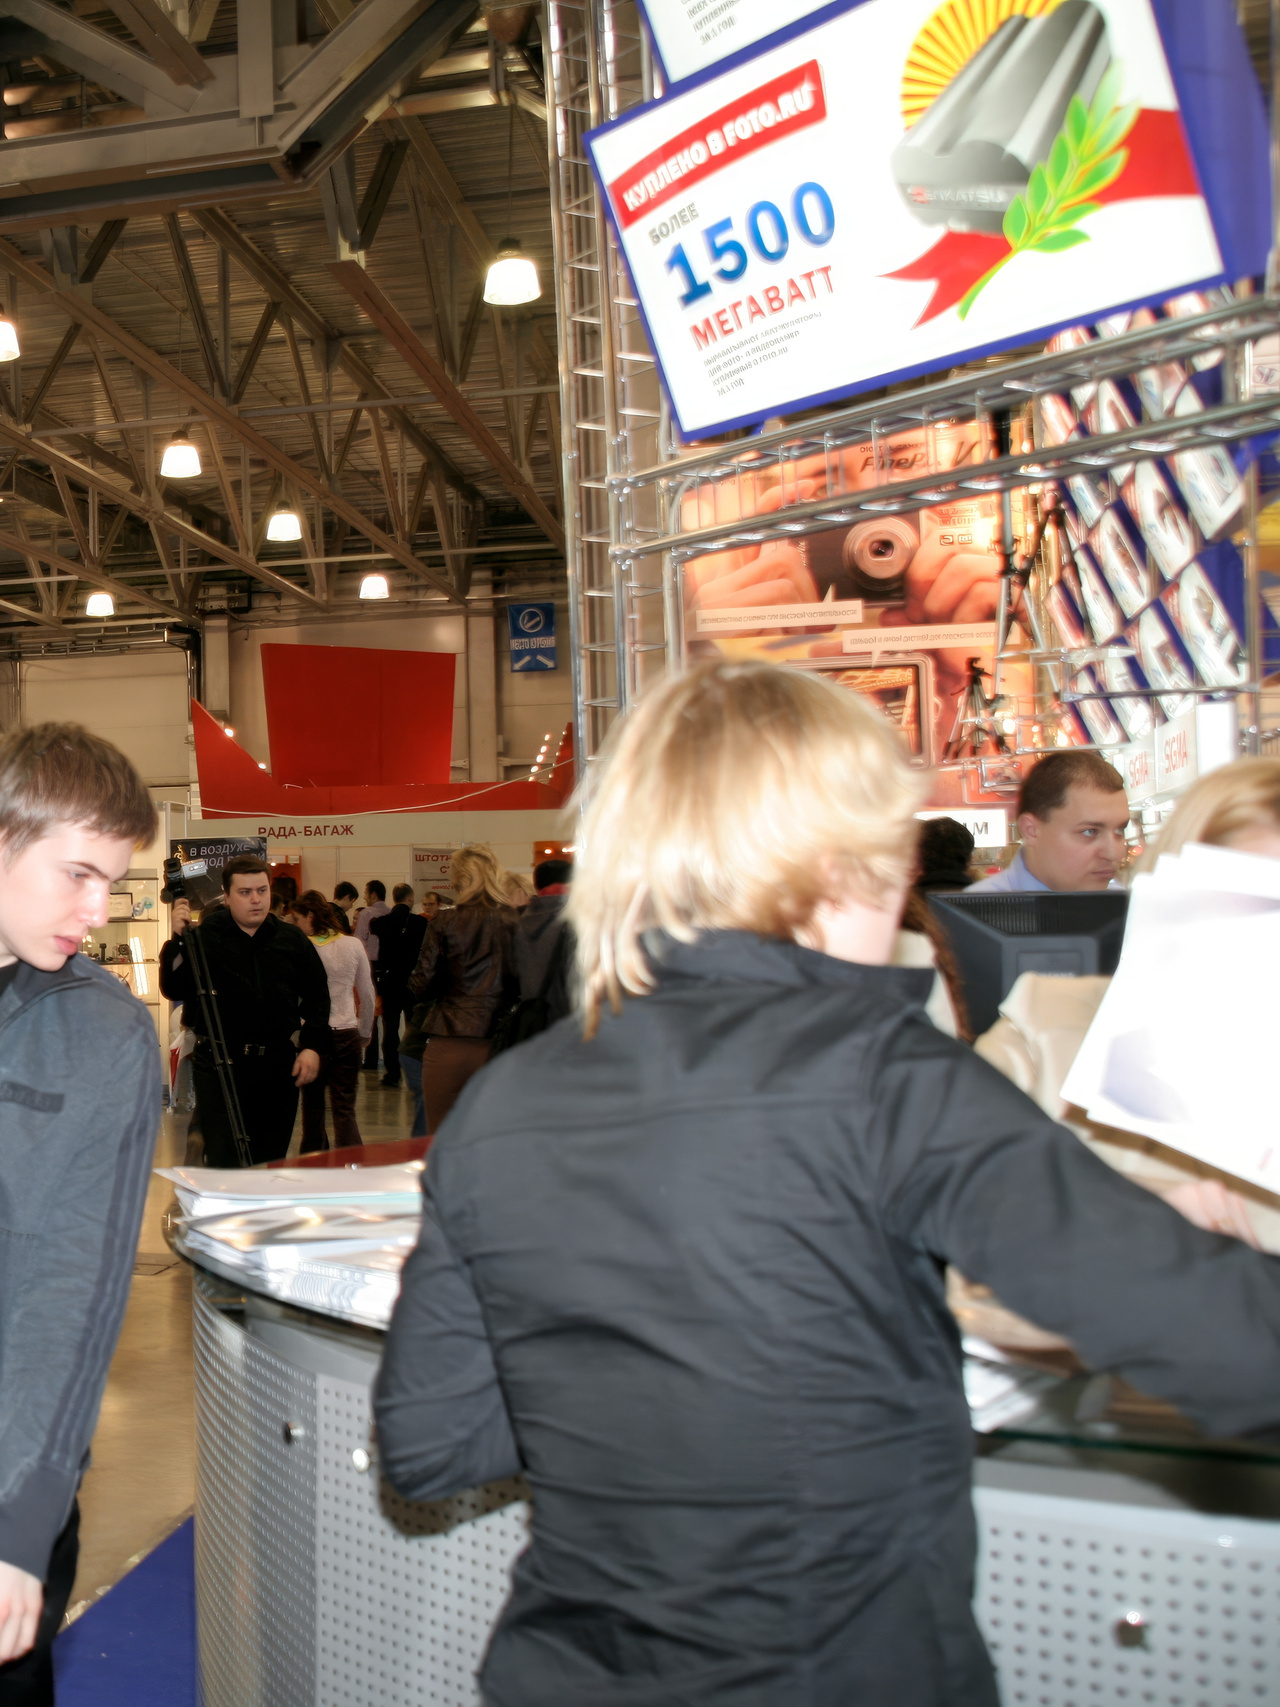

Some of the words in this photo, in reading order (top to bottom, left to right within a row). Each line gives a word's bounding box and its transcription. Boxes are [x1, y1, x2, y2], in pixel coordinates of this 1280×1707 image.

[622, 141, 709, 212] КУПЛЕНО
[706, 130, 725, 156] В
[723, 84, 815, 147] FOTO.RU
[648, 202, 699, 246] БОЛЕЕ
[664, 182, 835, 311] 1500
[689, 265, 834, 351] МЕГАВАТТ
[1164, 730, 1188, 774] SIGMA
[190, 848, 197, 857] В
[200, 843, 251, 856] ВОЗДУХЕ
[258, 824, 354, 839] РАДА-БАГАЖ
